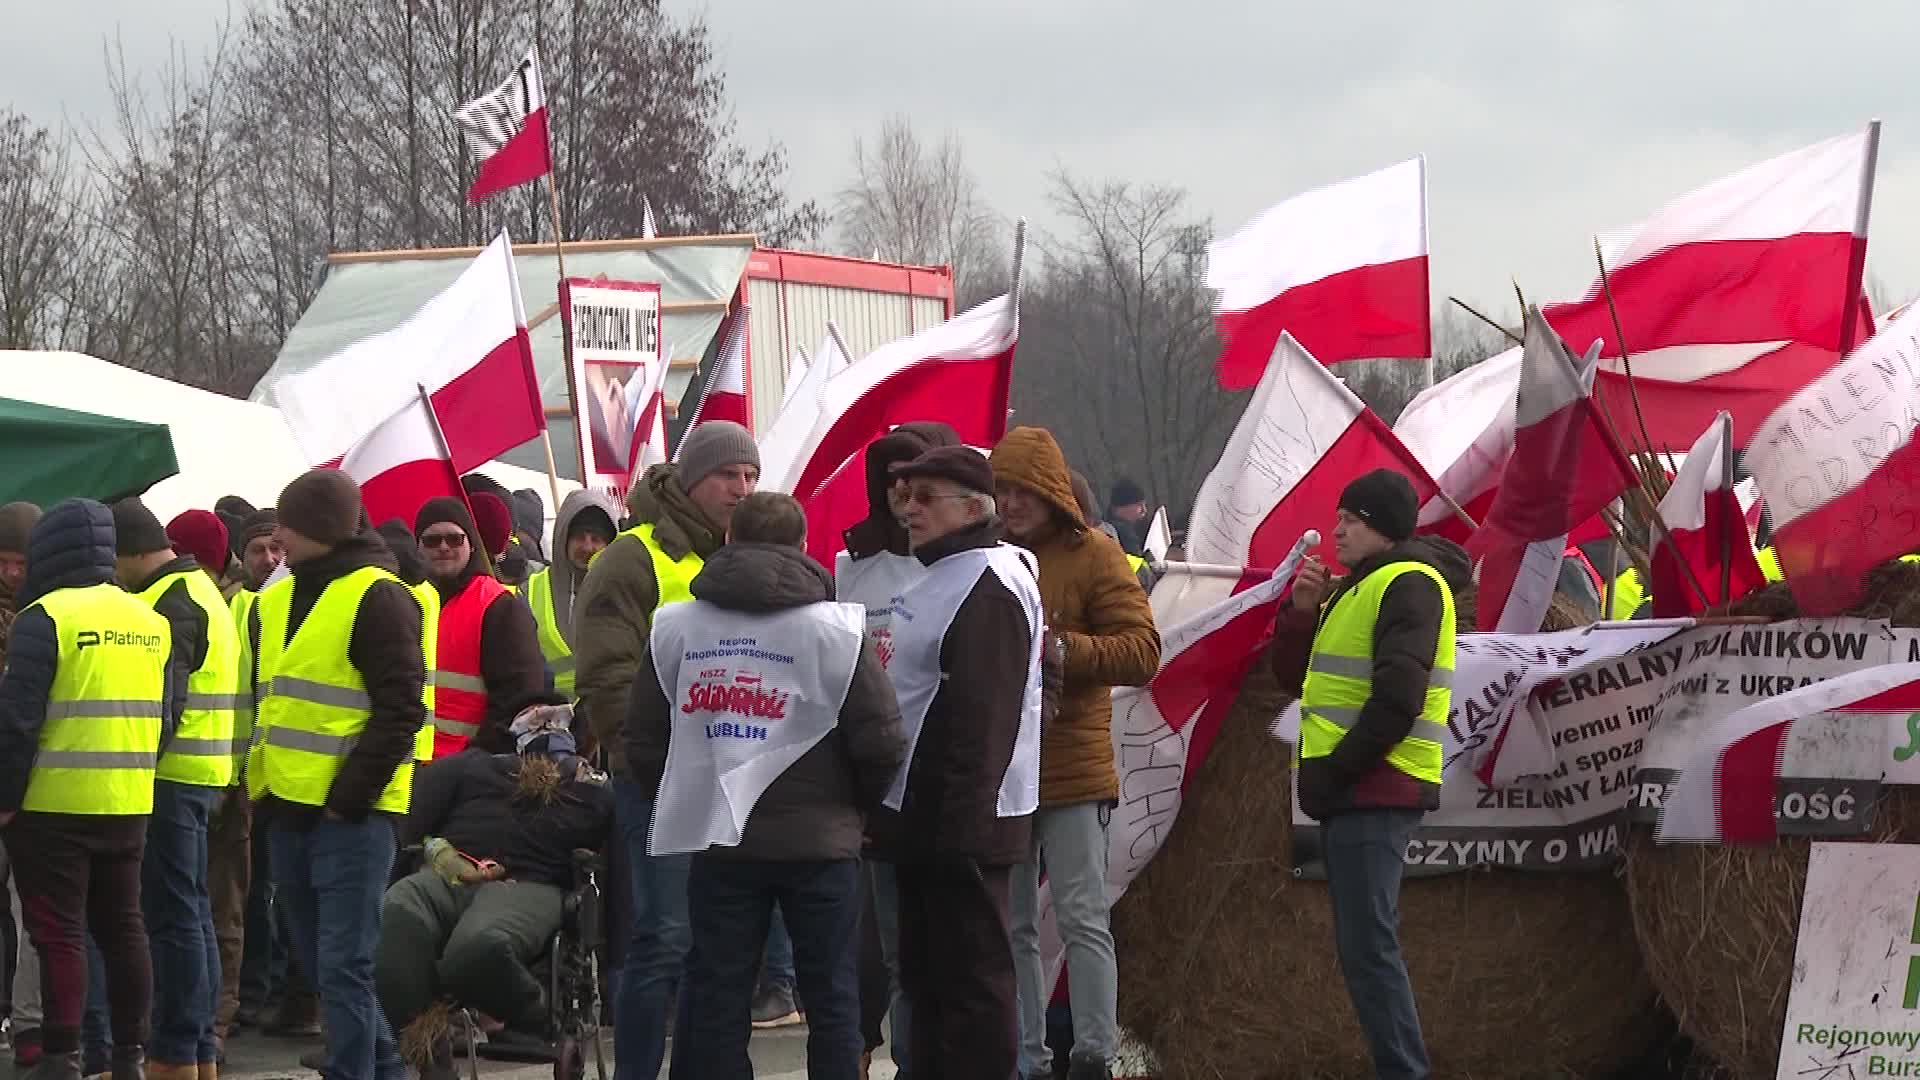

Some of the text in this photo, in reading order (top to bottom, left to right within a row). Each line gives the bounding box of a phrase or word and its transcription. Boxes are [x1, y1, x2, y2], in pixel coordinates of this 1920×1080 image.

[104, 630, 160, 647] Platinum
[719, 637, 757, 646] REGION
[700, 668, 727, 678] NSZZ
[705, 722, 767, 740] LUBLIN
[1575, 737, 1644, 774] spoza
[1543, 839, 1568, 863] O
[1797, 1023, 1920, 1052] Rejonowy
